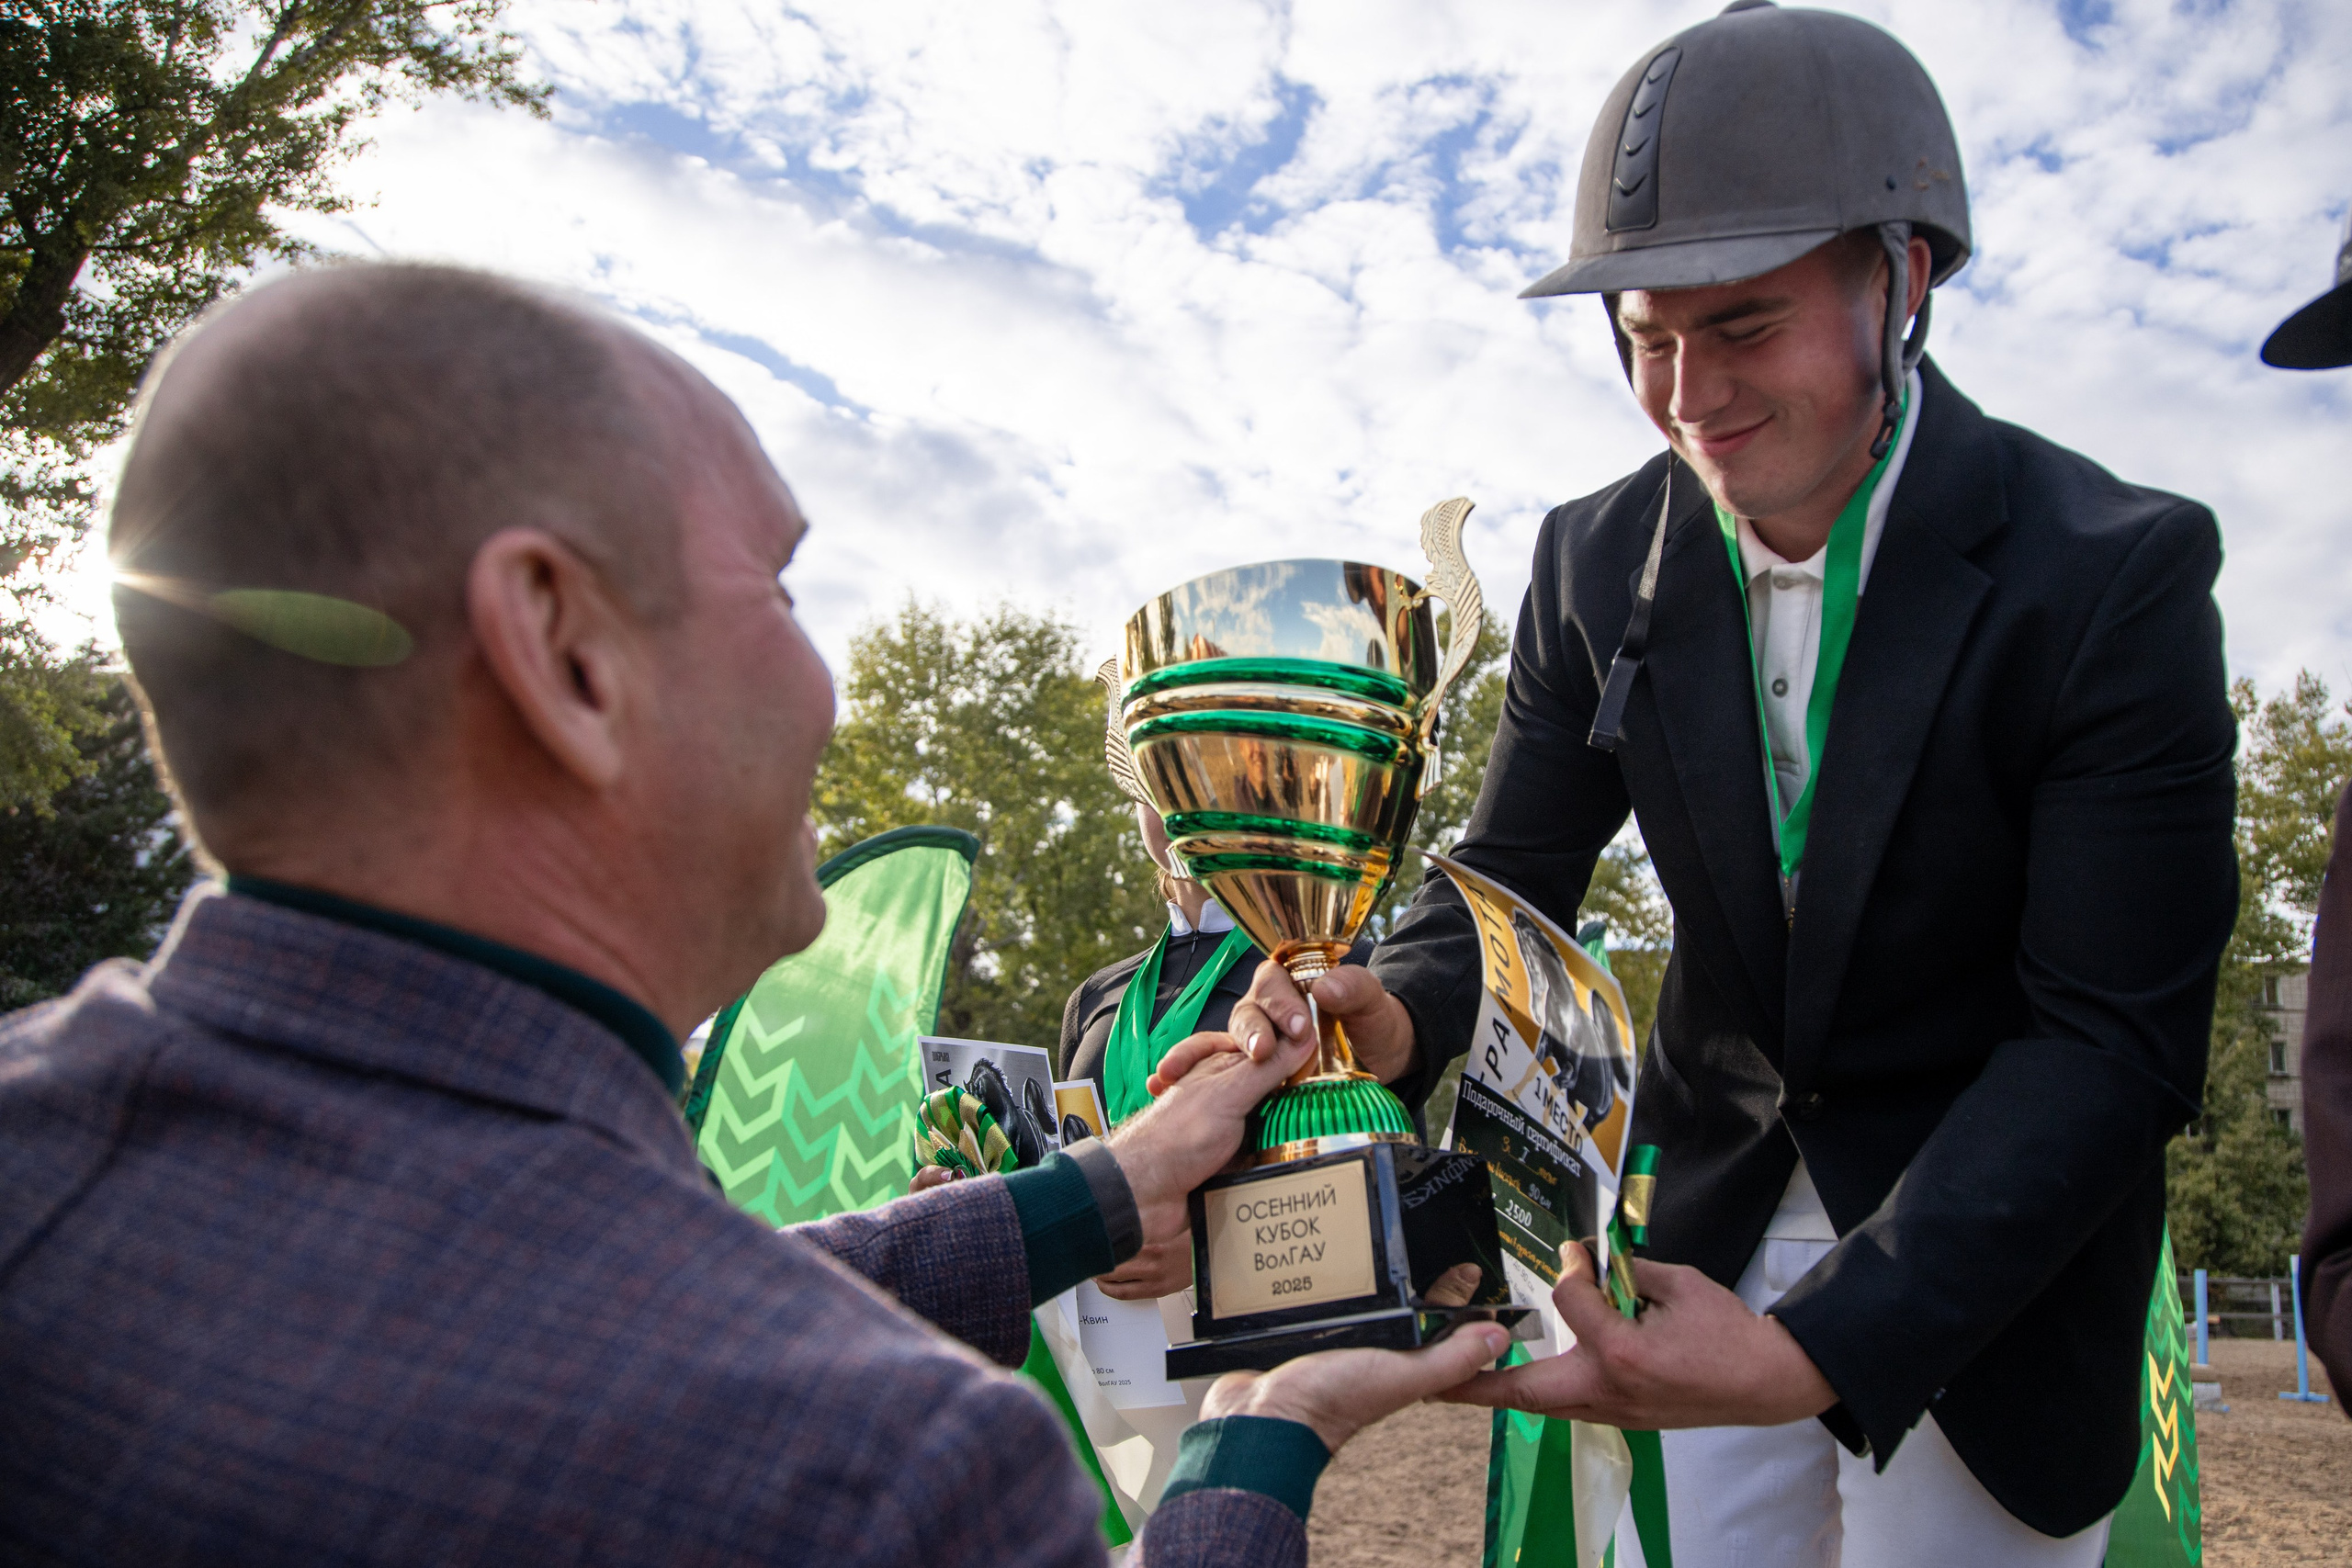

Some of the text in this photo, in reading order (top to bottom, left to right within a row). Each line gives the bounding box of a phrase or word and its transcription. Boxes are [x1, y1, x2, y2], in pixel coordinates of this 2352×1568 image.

[1462, 1078, 1582, 1177] Подарочный сертификат
[1543, 1087, 1583, 1156] МЕСТО
[1236, 1183, 1337, 1223] ОСЕННИЙ
[1528, 1183, 1541, 1201] 90
[1505, 1199, 1532, 1227] 2500
[1255, 1216, 1321, 1246] КУБОК
[1272, 1276, 1313, 1295] 2025
